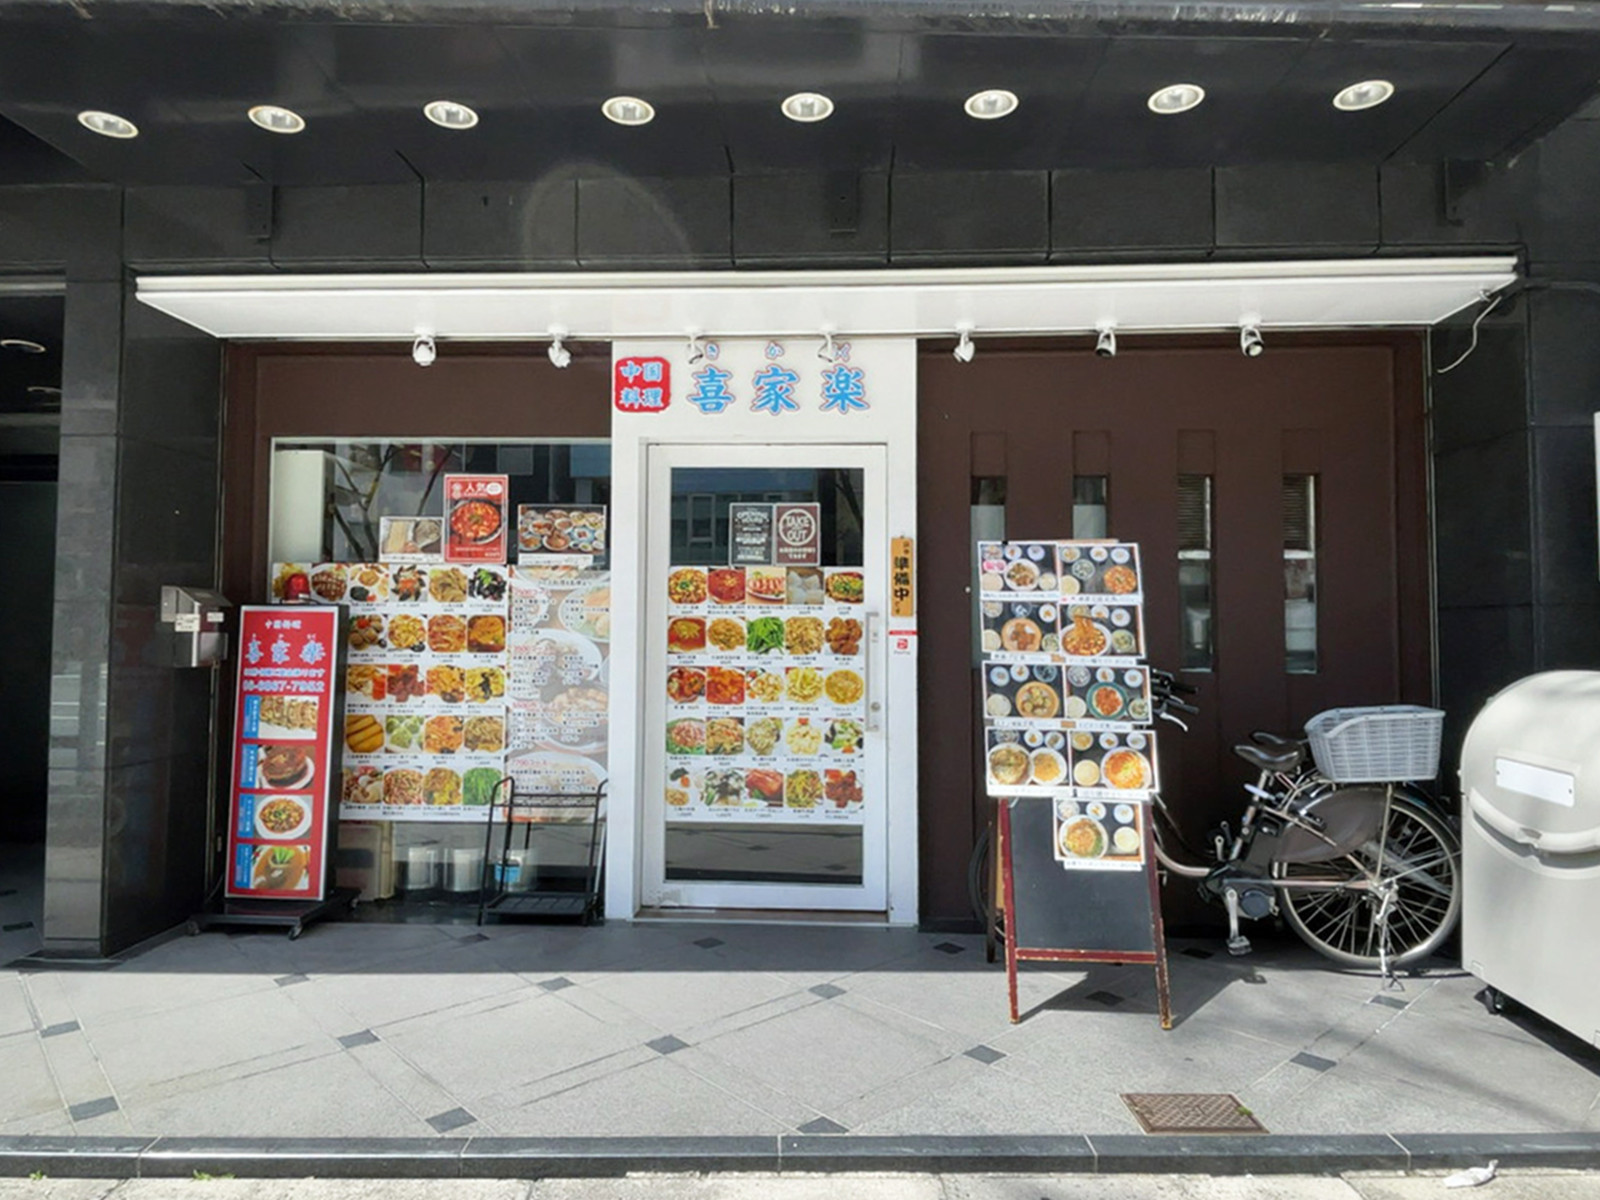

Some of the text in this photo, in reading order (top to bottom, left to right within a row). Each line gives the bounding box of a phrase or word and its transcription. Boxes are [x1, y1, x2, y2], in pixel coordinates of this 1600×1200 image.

[619, 360, 664, 383] 中国
[619, 386, 665, 410] 料理
[688, 364, 871, 415] 喜家楽
[786, 515, 810, 526] TAKE
[786, 529, 807, 542] OUT
[893, 556, 910, 602] 準備中
